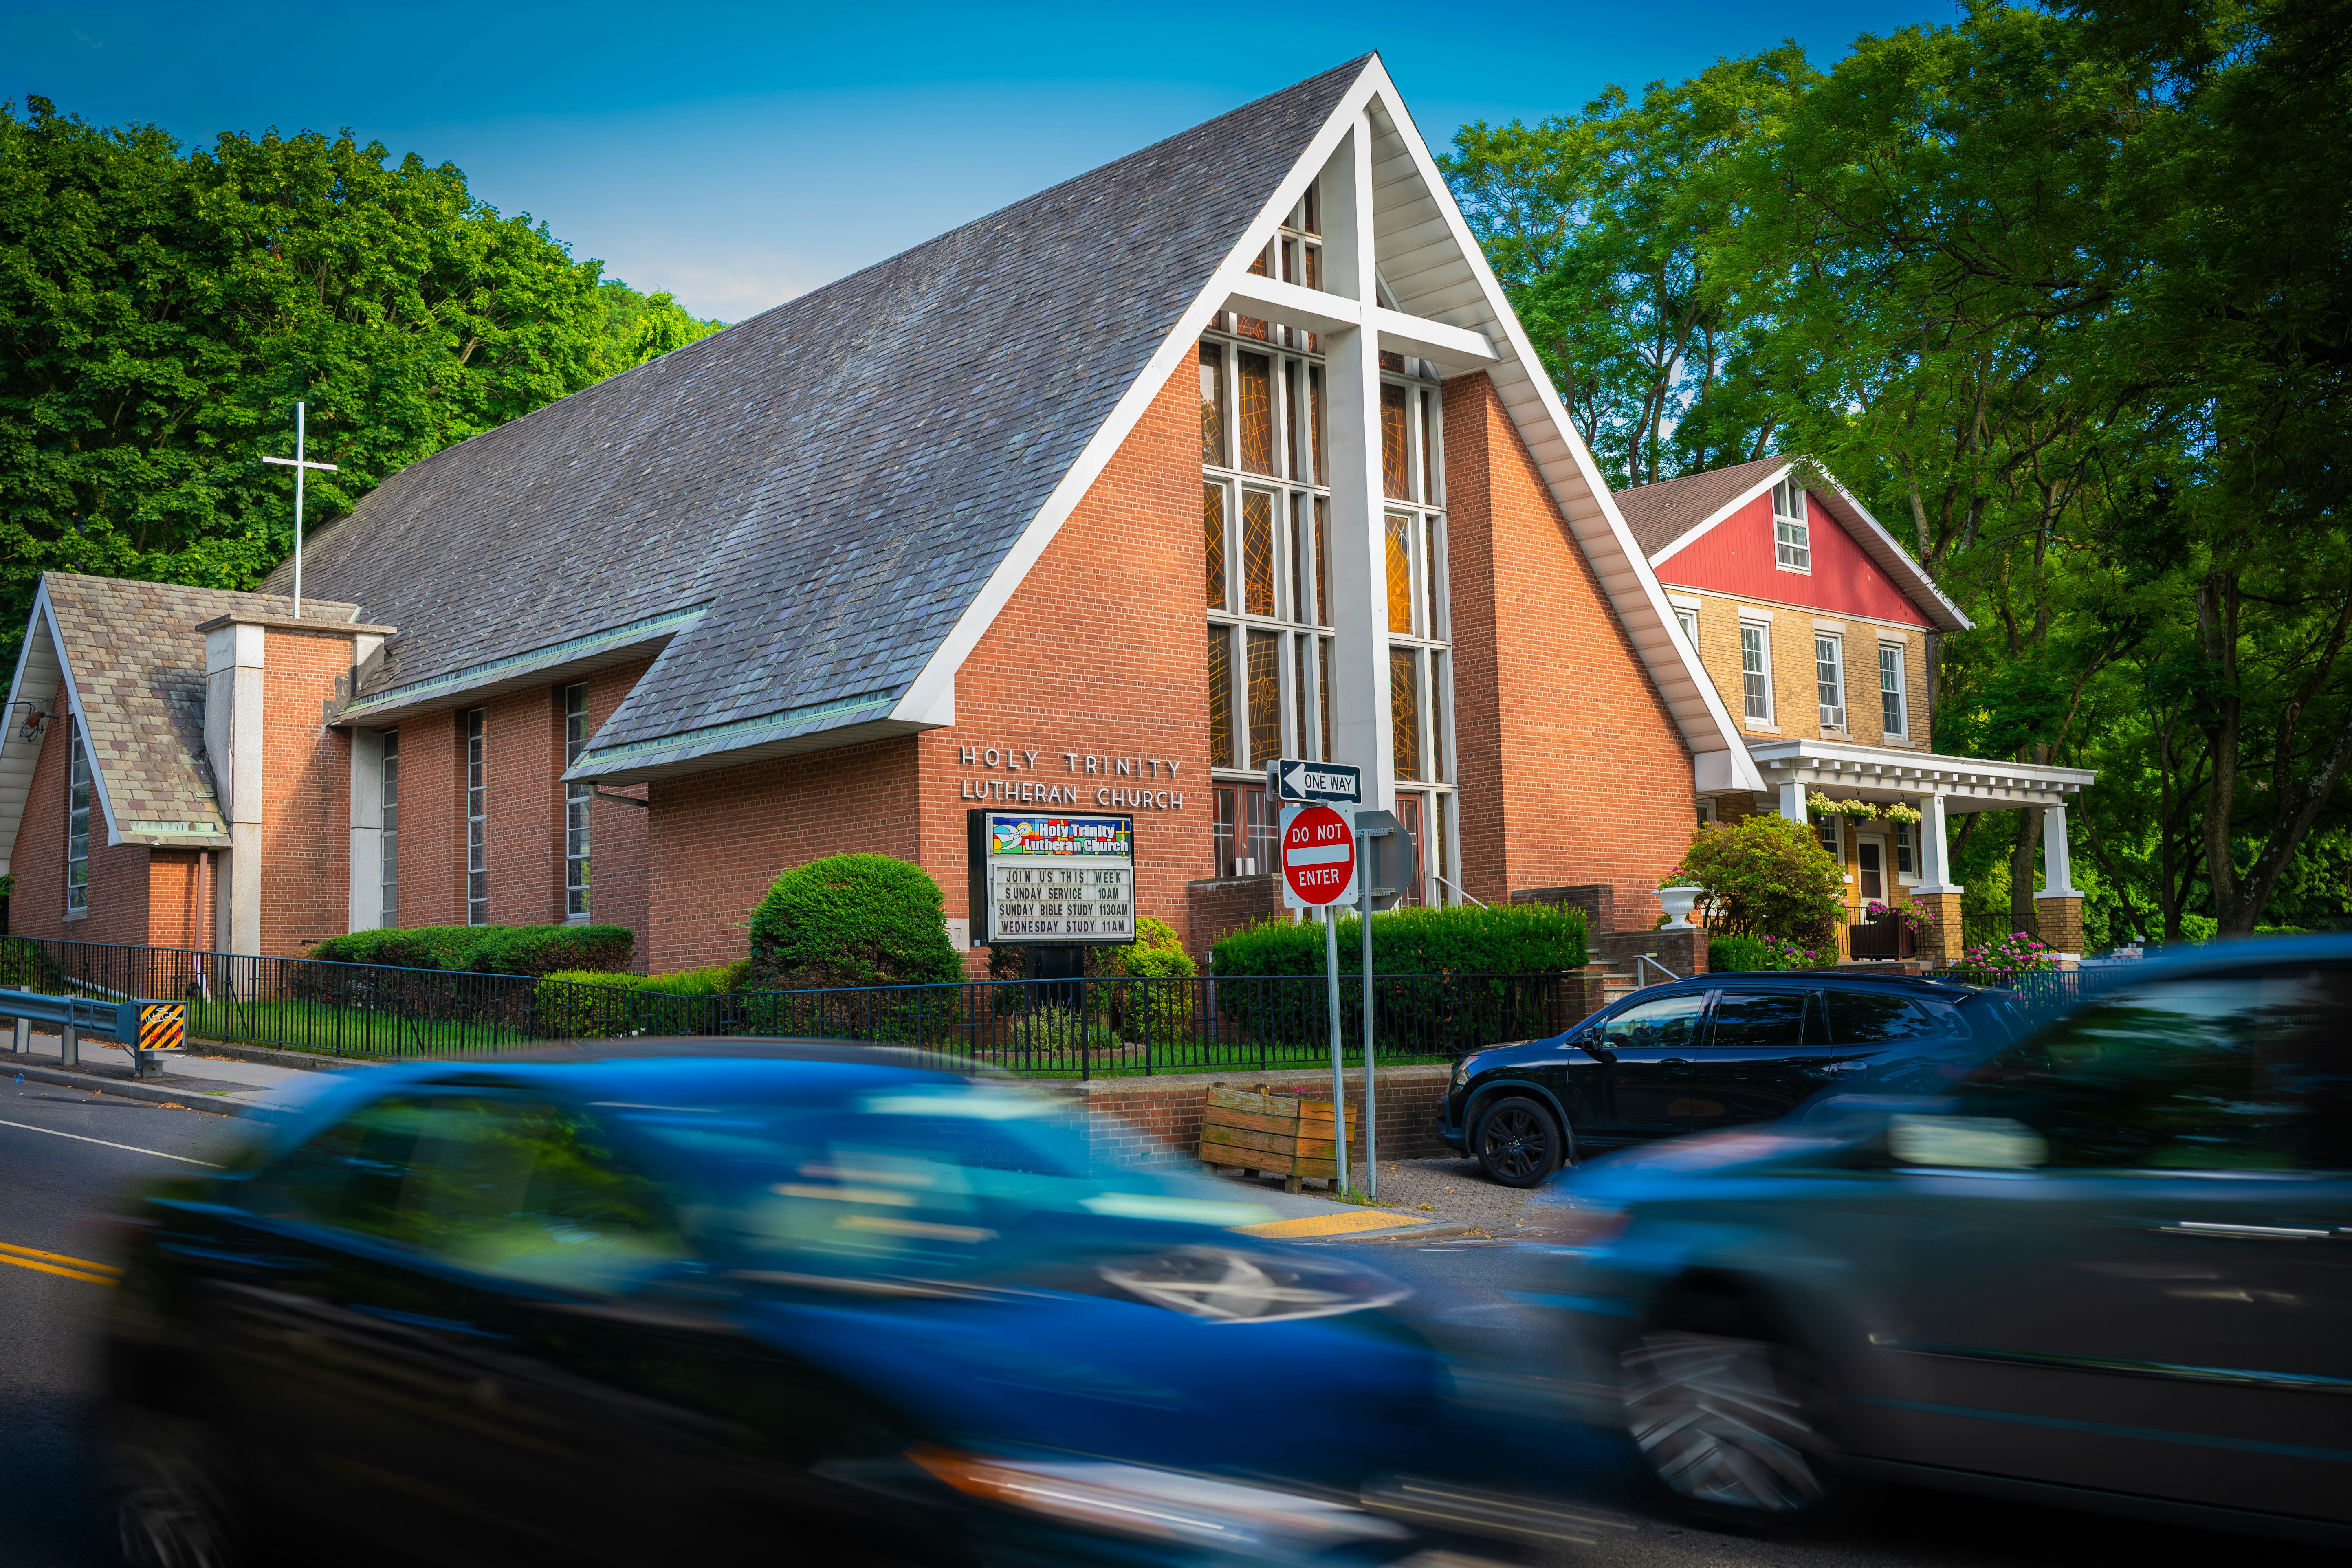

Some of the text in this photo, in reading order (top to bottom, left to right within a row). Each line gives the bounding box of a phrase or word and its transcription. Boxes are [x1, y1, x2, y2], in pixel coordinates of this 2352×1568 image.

[961, 746, 1180, 779] HOLY TRINITY
[1305, 774, 1352, 792] ONE WAY
[962, 779, 1182, 809] LUTHERAN CHURCH
[1039, 823, 1115, 838] Holy Trinity
[1292, 823, 1342, 843] DO NOT
[1025, 838, 1129, 852] Lutheran Church
[1006, 871, 1121, 883] JOIN US THIS WEEK
[1299, 869, 1340, 886] ENTER
[1005, 887, 1119, 899] SUNDAY SERVICE 10AM
[999, 904, 1128, 916] SUNDAY BIBLE STUDY 1130AM
[1001, 920, 1124, 932] WEDNESDAY STUDY 11AM
